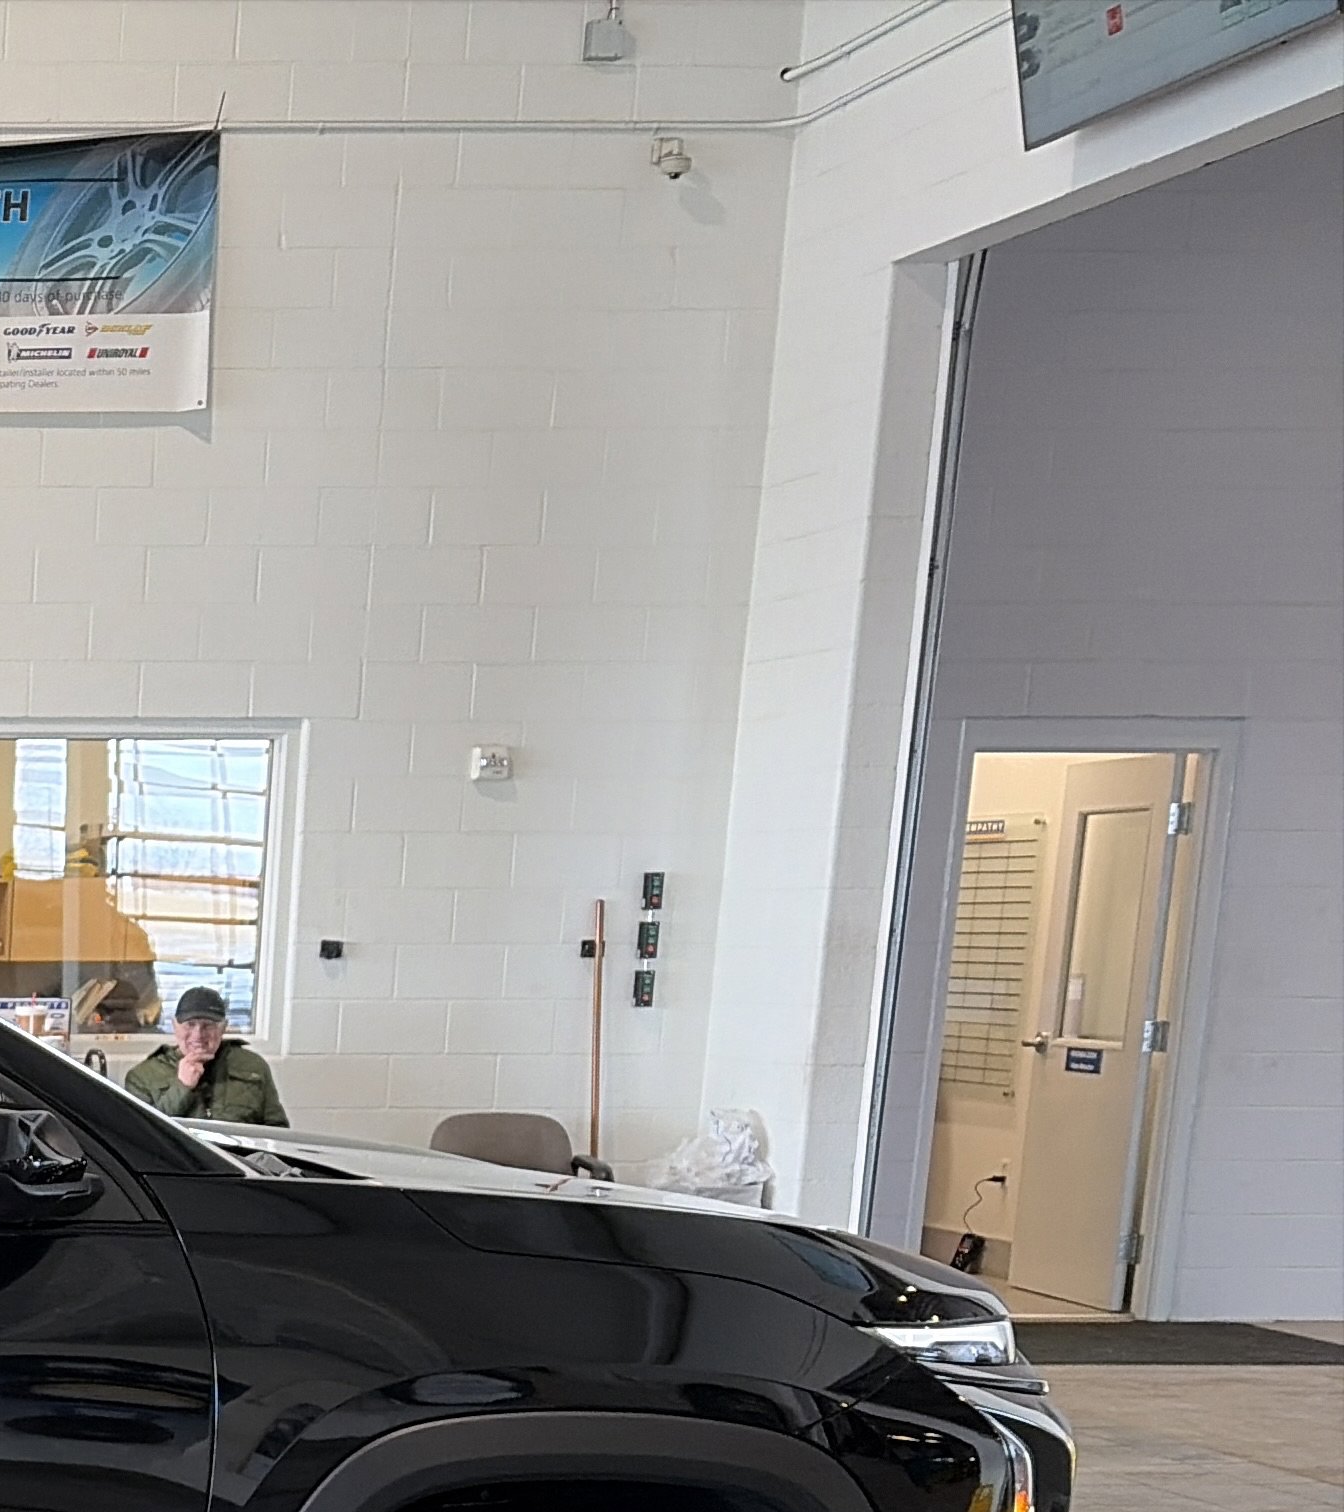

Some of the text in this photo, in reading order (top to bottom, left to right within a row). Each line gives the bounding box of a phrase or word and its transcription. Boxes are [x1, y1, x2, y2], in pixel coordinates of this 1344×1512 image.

[15, 290, 44, 303] days
[3, 323, 76, 337] GOODYEAR
[19, 349, 71, 358] MICHELIN
[96, 348, 139, 359] UNIROYAL
[56, 368, 87, 377] located
[88, 368, 115, 377] within
